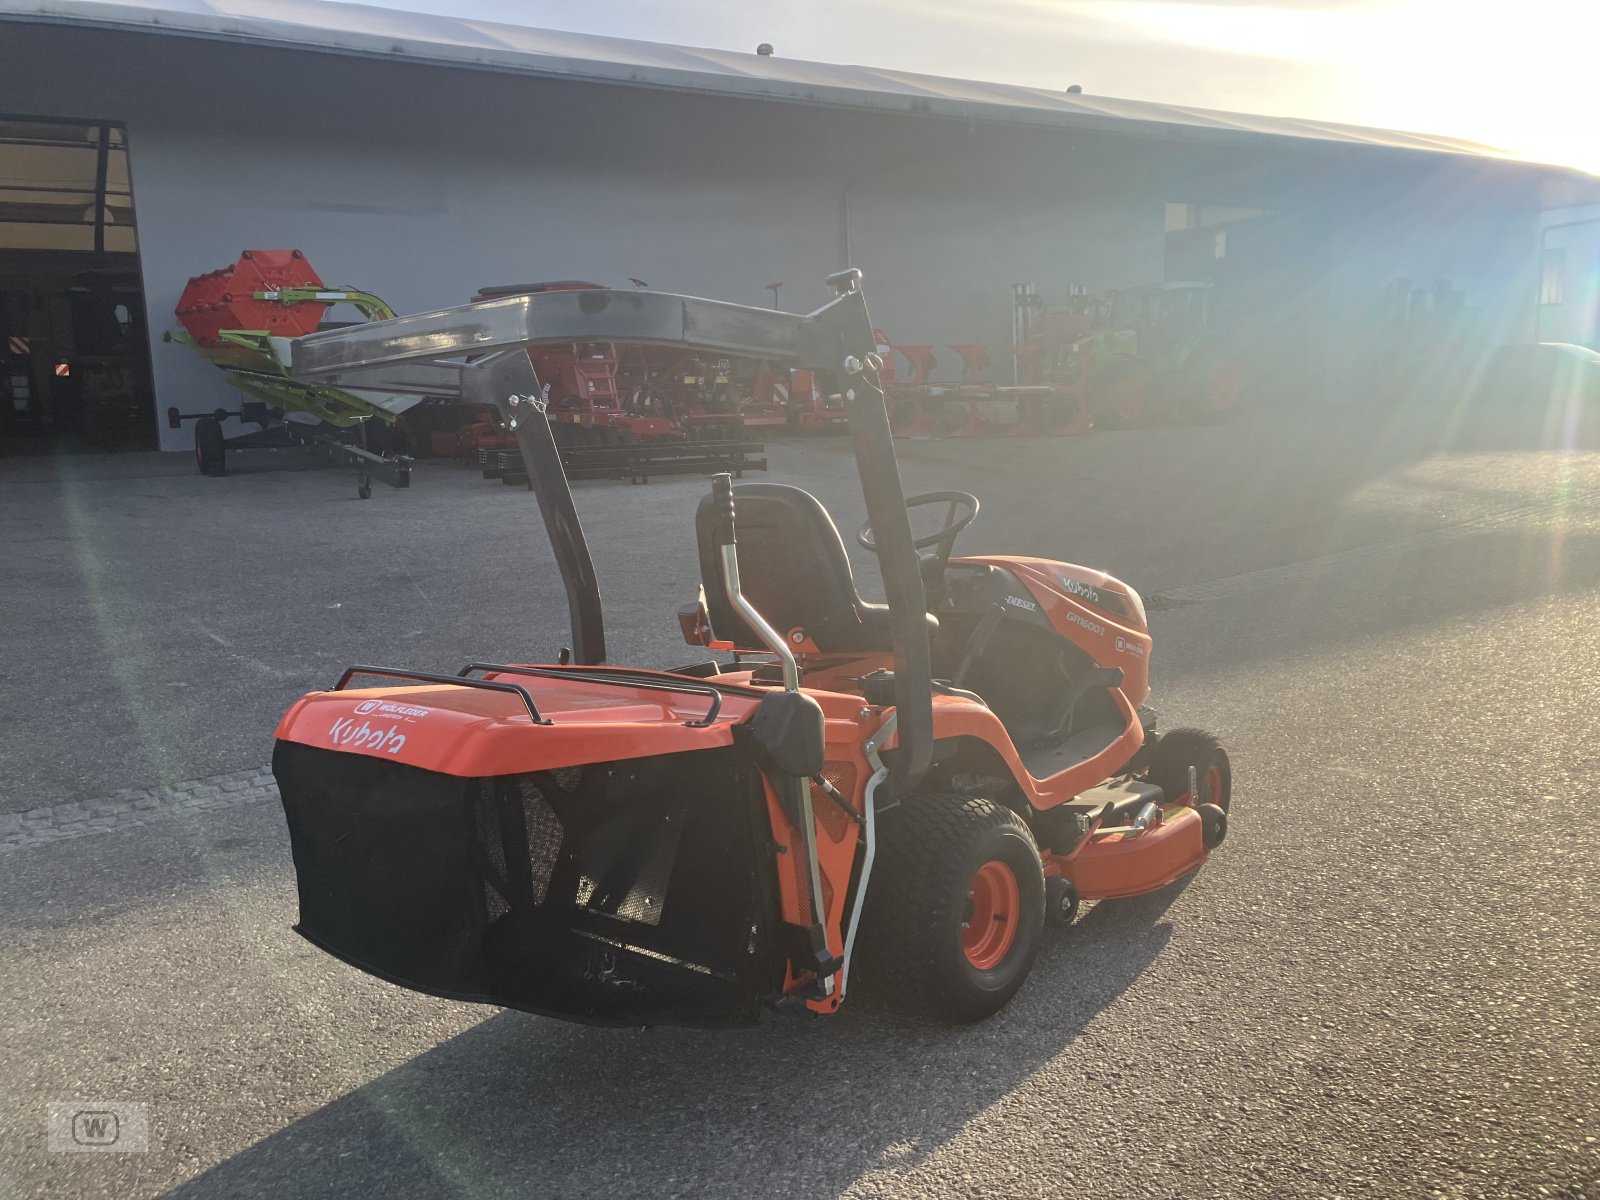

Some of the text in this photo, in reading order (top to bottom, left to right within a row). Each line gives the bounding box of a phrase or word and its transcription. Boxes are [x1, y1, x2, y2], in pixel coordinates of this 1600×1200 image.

[1063, 577, 1099, 602] Kubota
[1006, 596, 1036, 612] DIESEL
[329, 717, 406, 753] Kubota
